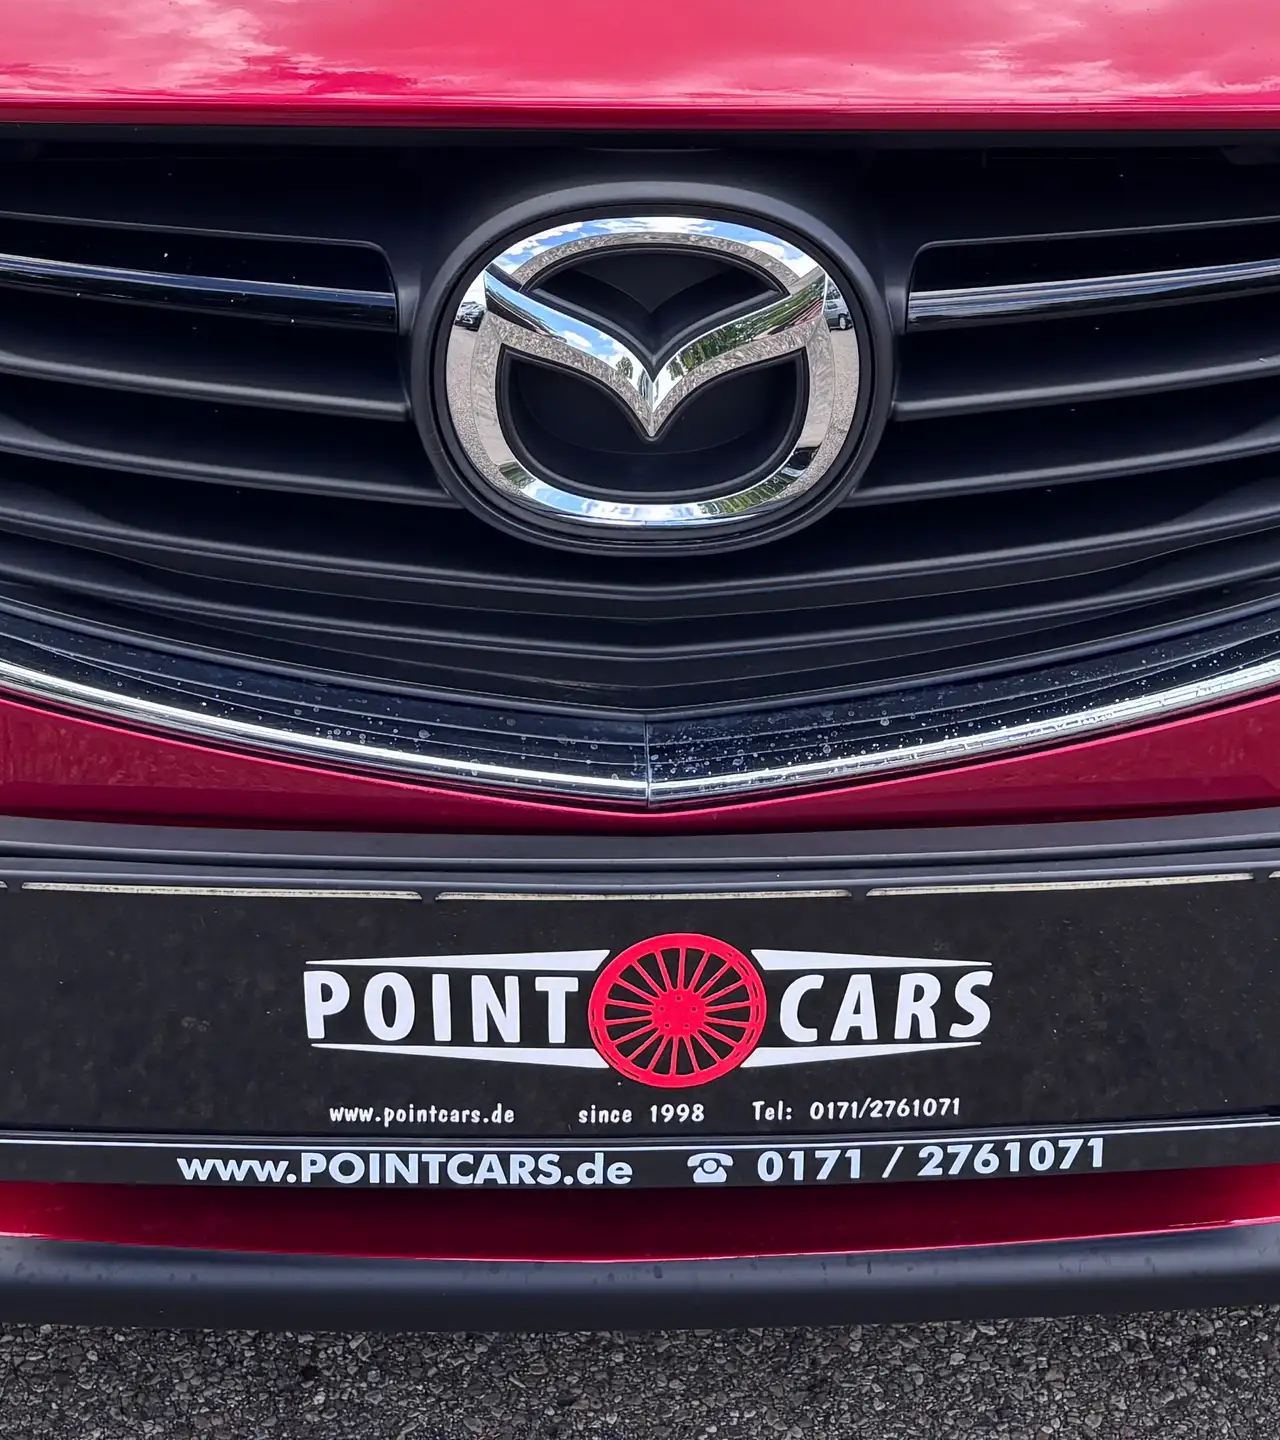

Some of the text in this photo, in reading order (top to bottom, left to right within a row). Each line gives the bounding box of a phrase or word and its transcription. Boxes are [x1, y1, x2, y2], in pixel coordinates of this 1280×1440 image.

[303, 970, 994, 1044] POINT CARS
[328, 1096, 960, 1128] www.pointcars.de since 1998 Tel: 0171/2761071
[175, 1152, 634, 1186] www.POINTCARS.de
[757, 1148, 862, 1182] 0171
[917, 1137, 1105, 1177] 2761071
